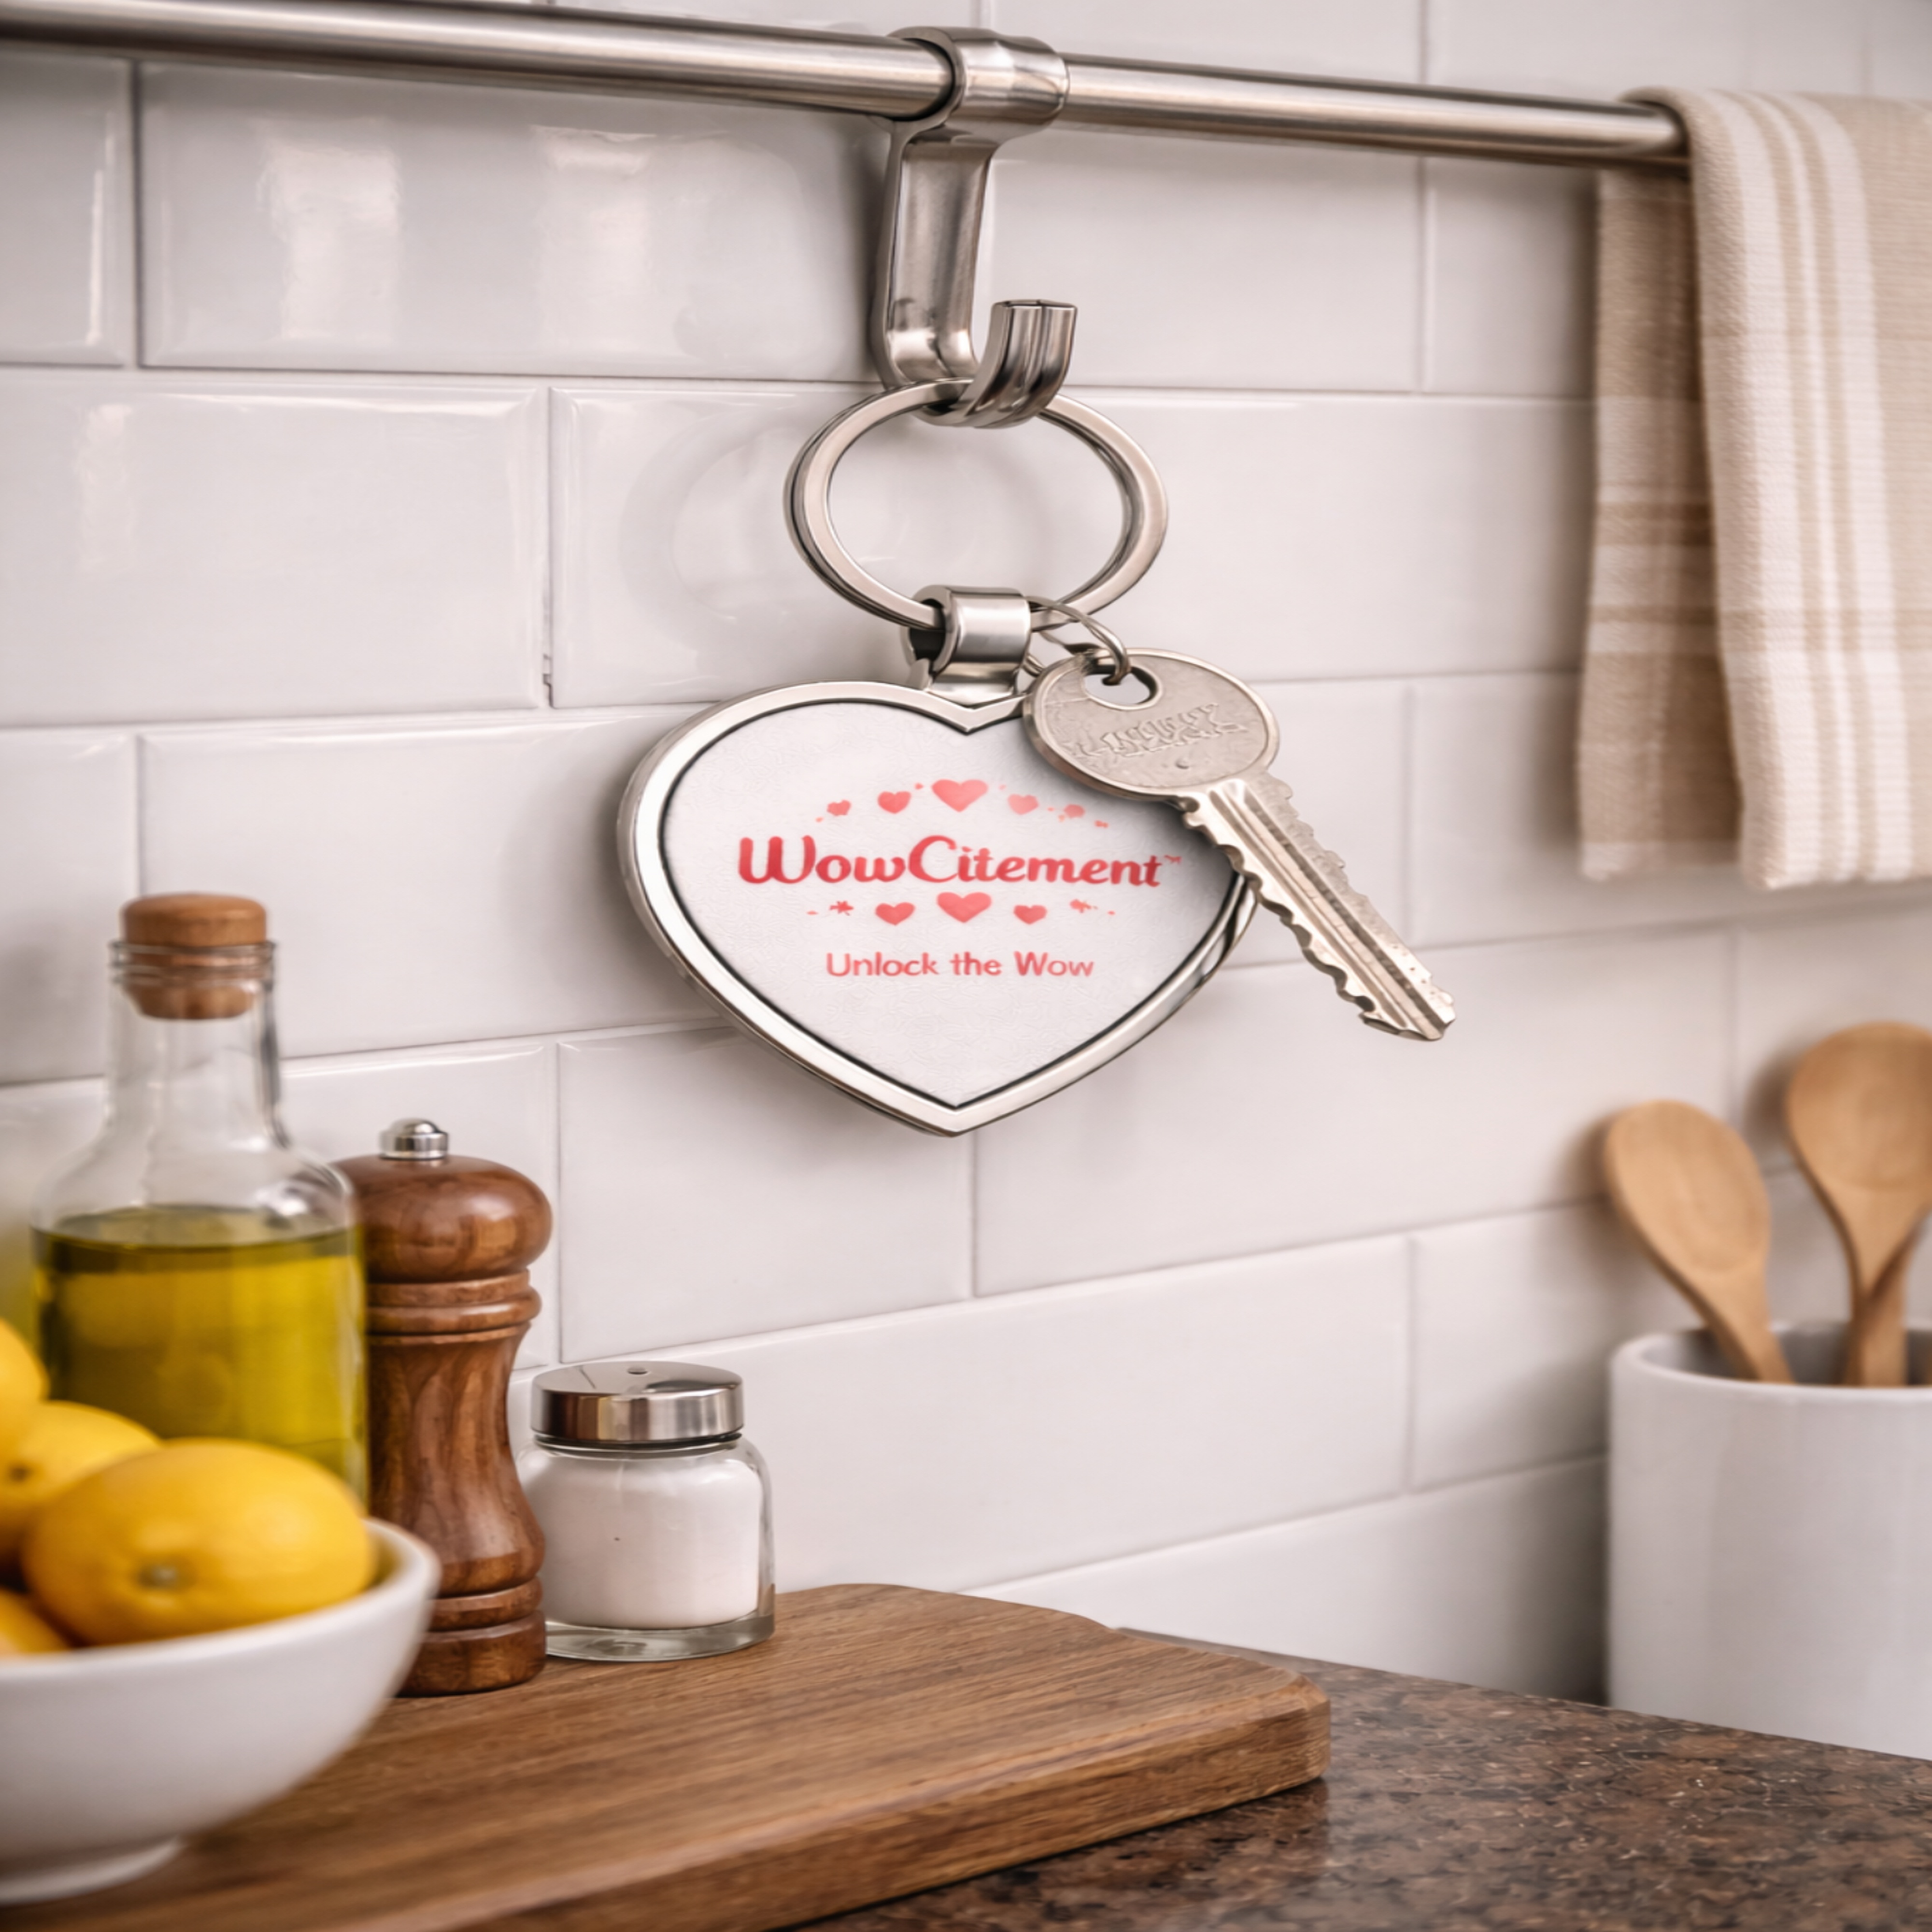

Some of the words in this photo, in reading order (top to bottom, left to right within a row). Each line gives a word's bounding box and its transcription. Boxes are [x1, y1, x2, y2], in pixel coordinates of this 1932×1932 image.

[826, 951, 939, 977] Unlock
[950, 951, 1002, 976] the
[1013, 951, 1094, 977] Wow
